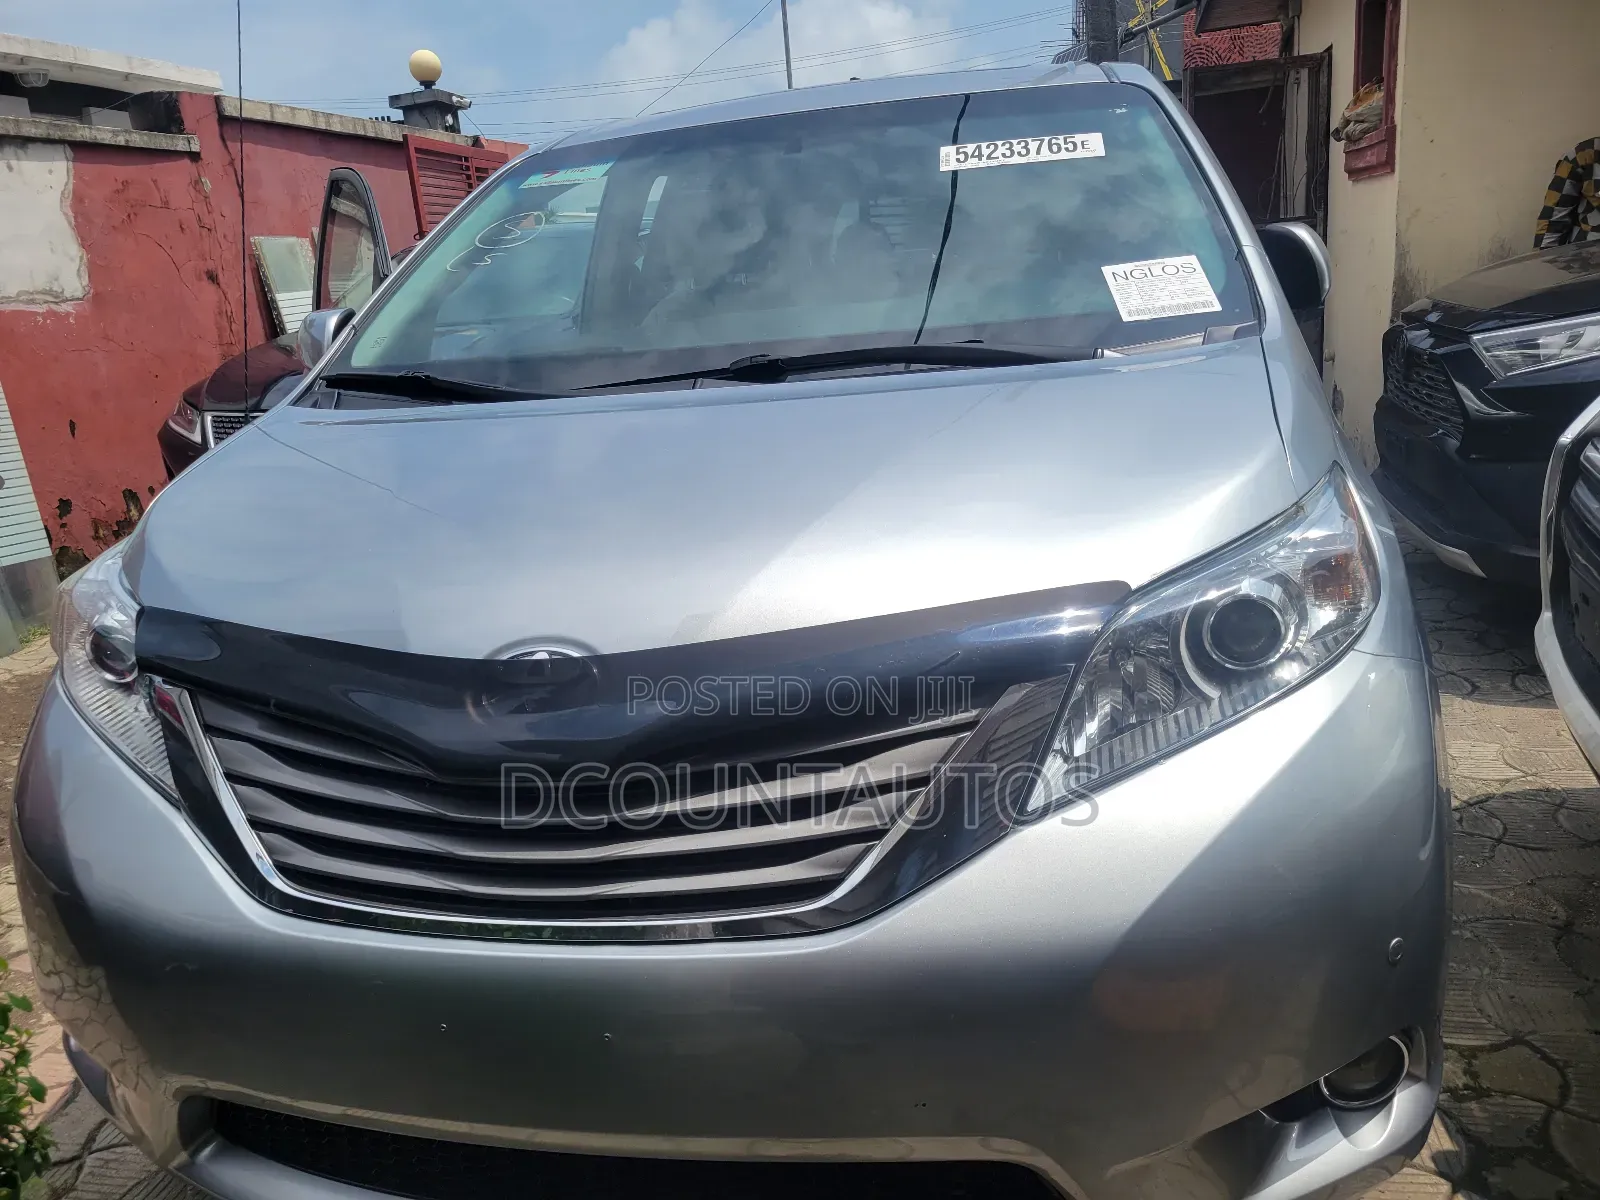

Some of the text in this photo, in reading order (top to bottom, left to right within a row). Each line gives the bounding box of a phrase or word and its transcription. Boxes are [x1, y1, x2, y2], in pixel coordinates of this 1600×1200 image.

[955, 136, 1078, 164] 54233765
[1080, 139, 1091, 150] E
[1112, 262, 1197, 282] NGLOS
